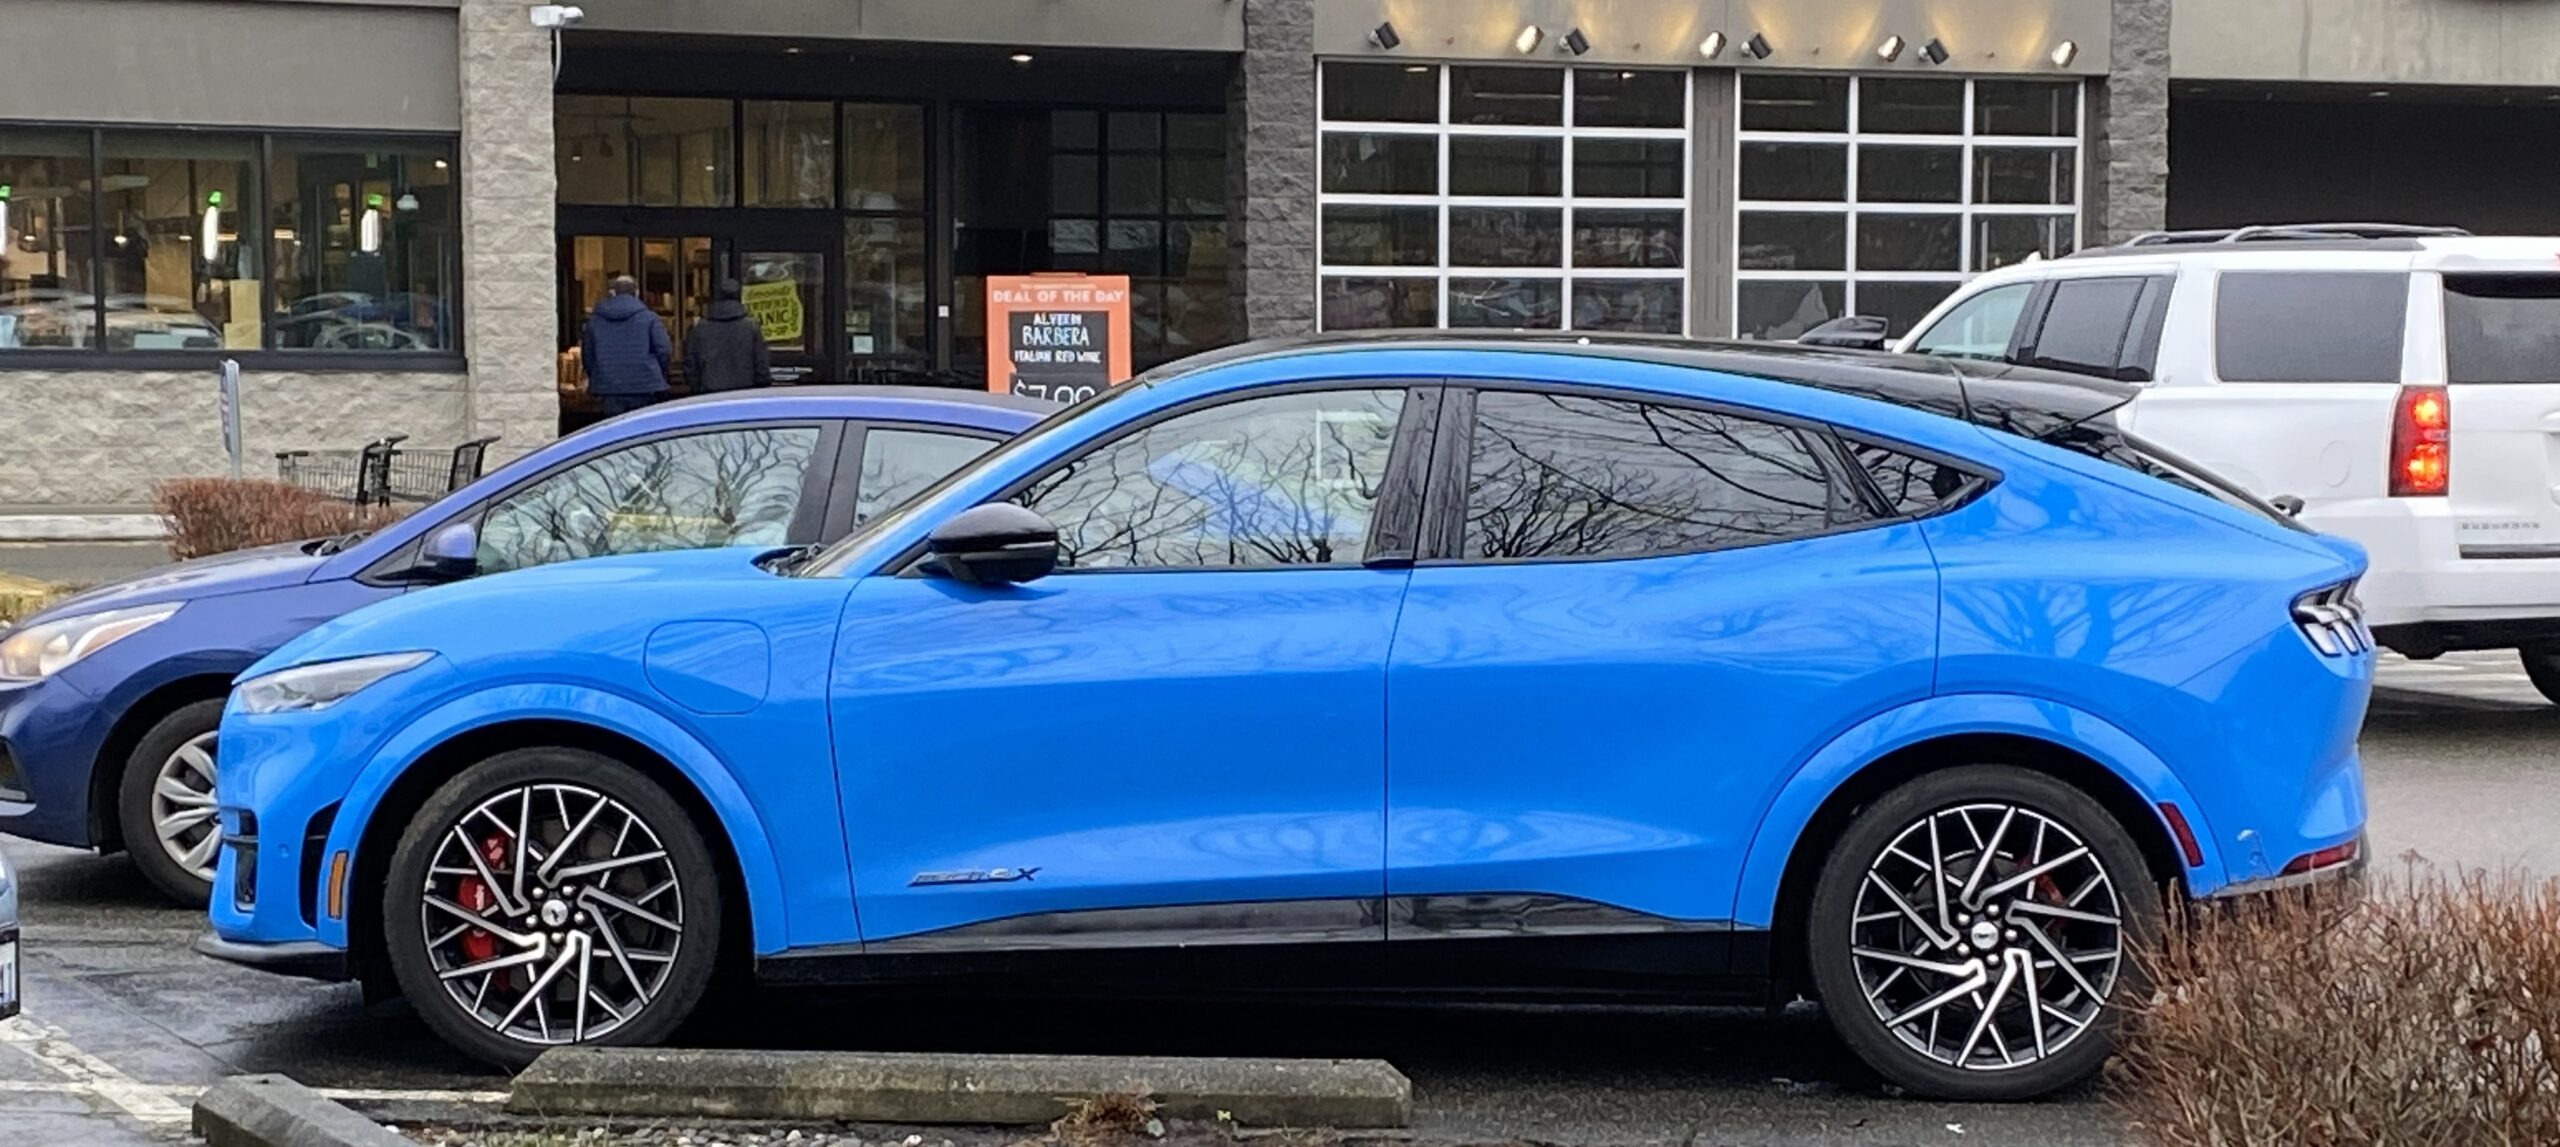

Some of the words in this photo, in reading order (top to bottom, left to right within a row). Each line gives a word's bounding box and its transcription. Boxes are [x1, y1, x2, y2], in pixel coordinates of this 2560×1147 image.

[993, 290, 1031, 303] DEAL
[1037, 290, 1057, 303] OF
[1063, 290, 1090, 303] THE
[1095, 290, 1123, 303] DAY
[1022, 326, 1090, 346] BARBERA
[1014, 350, 1052, 362] ITALIAN
[1055, 350, 1075, 362] RED
[1076, 351, 1101, 363] WINE
